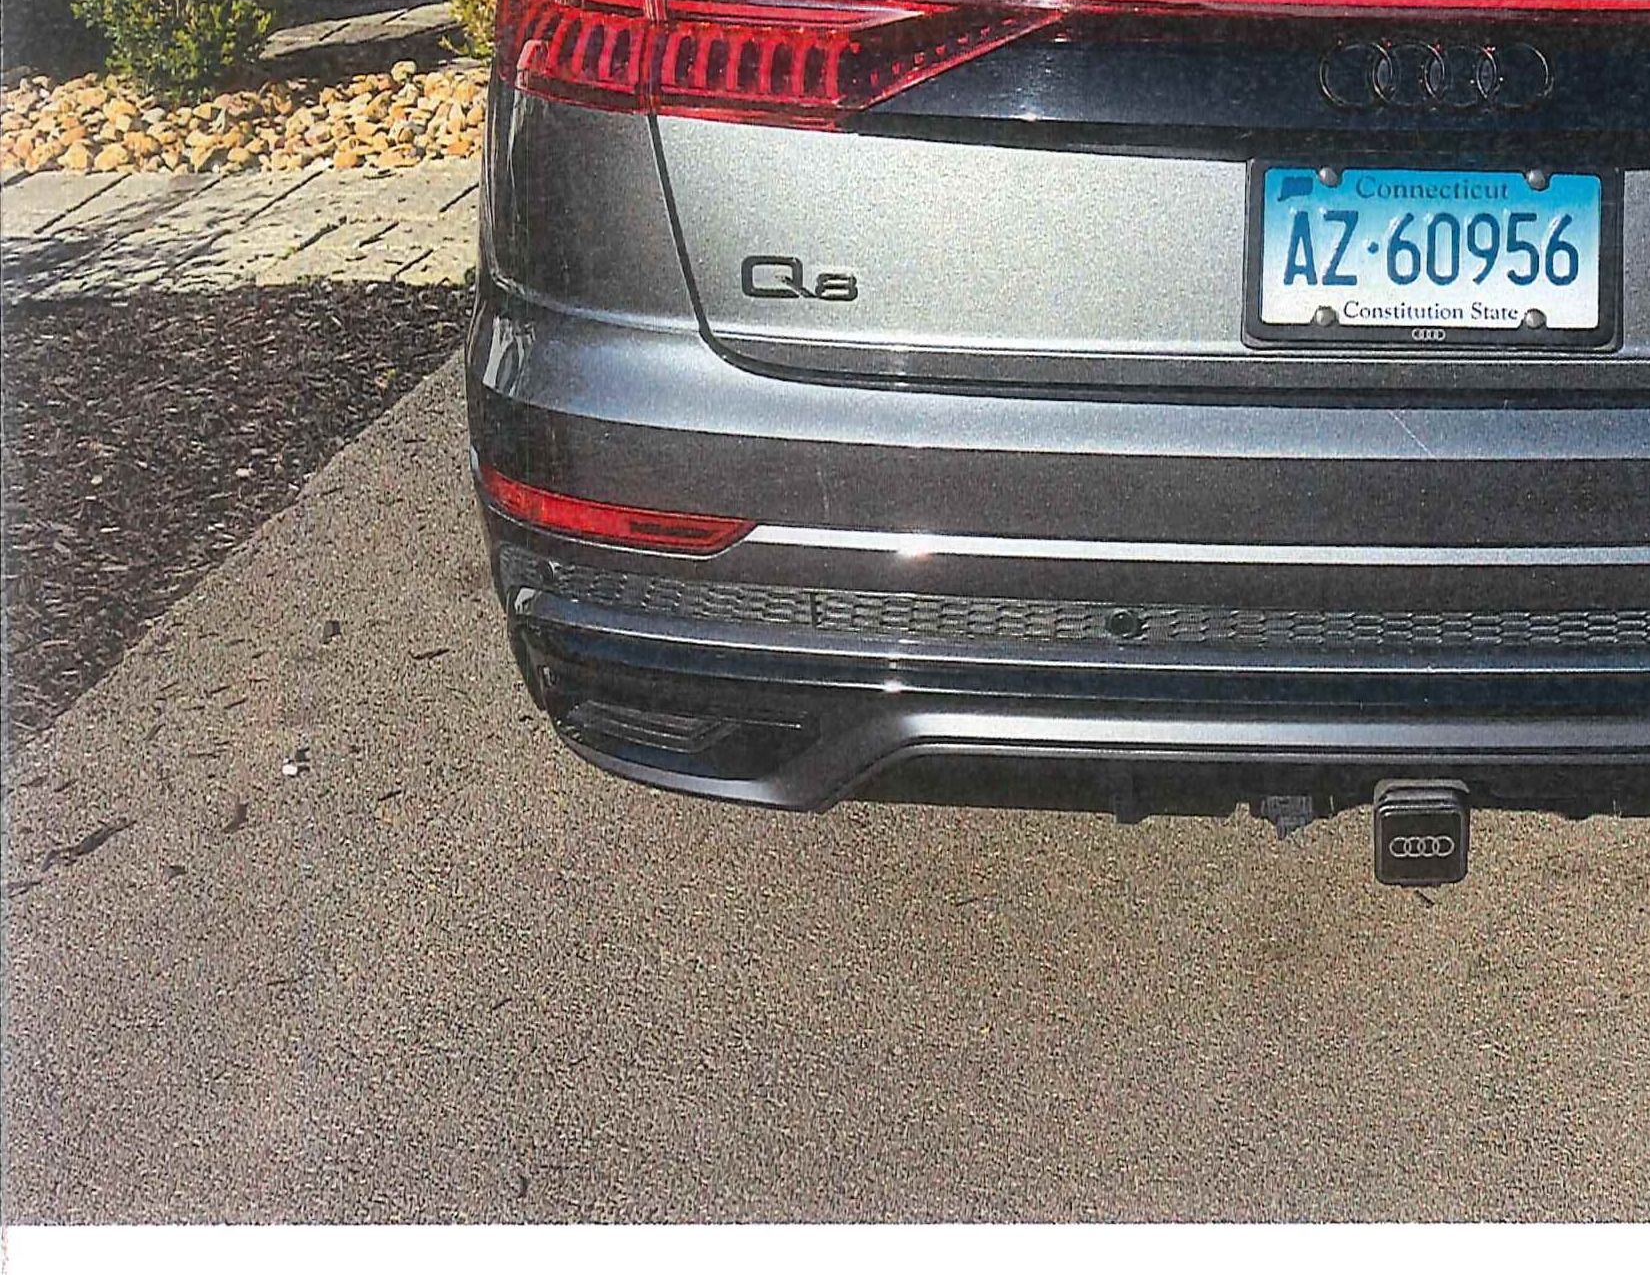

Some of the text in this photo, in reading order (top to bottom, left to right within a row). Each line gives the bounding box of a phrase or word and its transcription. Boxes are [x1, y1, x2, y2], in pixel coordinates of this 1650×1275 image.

[1355, 176, 1509, 200] Connecticut
[741, 255, 858, 301] Q8
[1343, 301, 1519, 321] Constitution State
